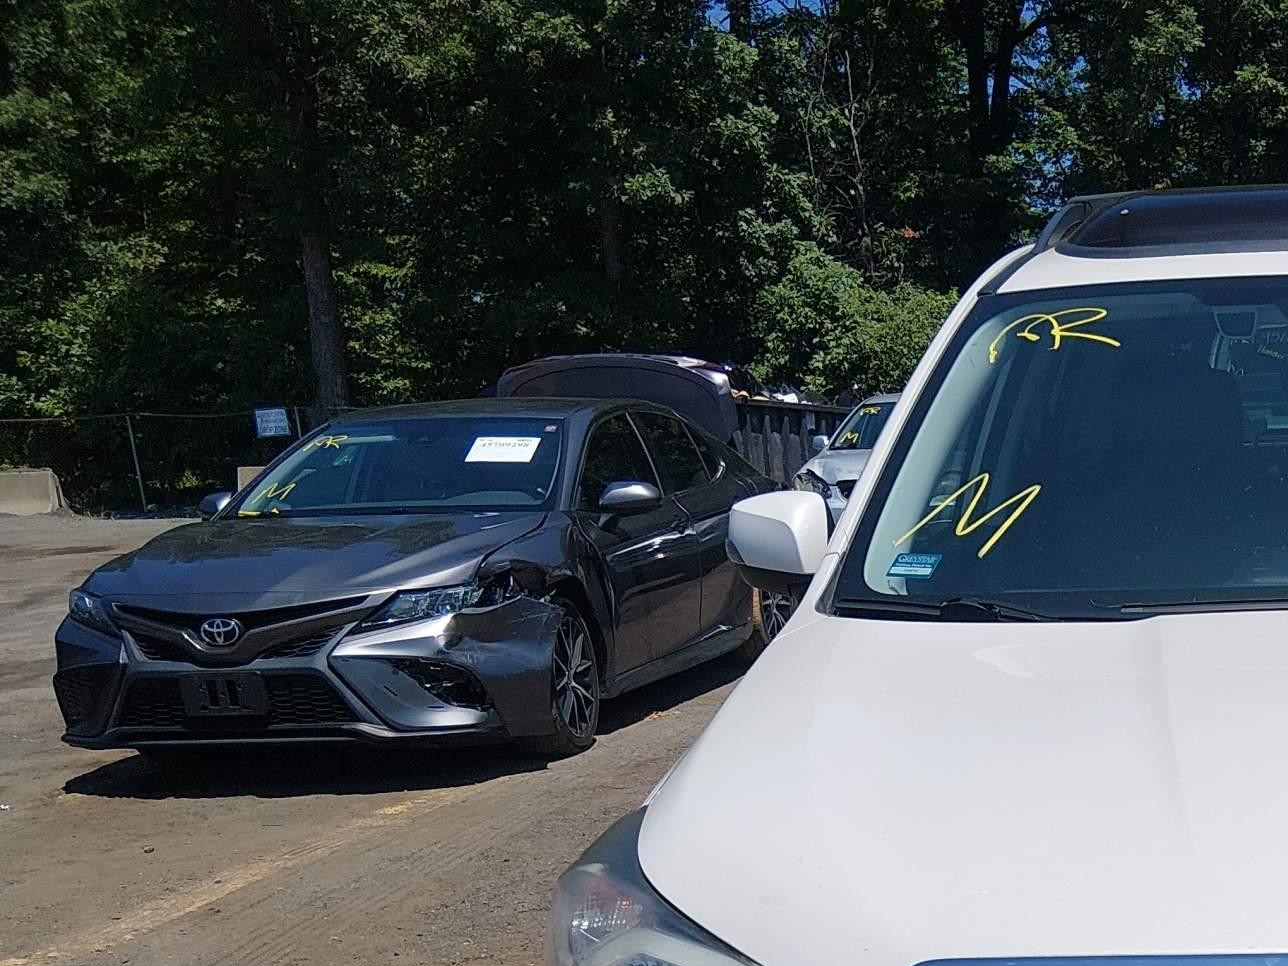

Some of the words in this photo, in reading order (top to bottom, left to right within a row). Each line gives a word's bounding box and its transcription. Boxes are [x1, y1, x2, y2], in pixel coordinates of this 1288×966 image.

[839, 431, 859, 443] M
[252, 482, 296, 504] M
[892, 472, 1041, 559] M
